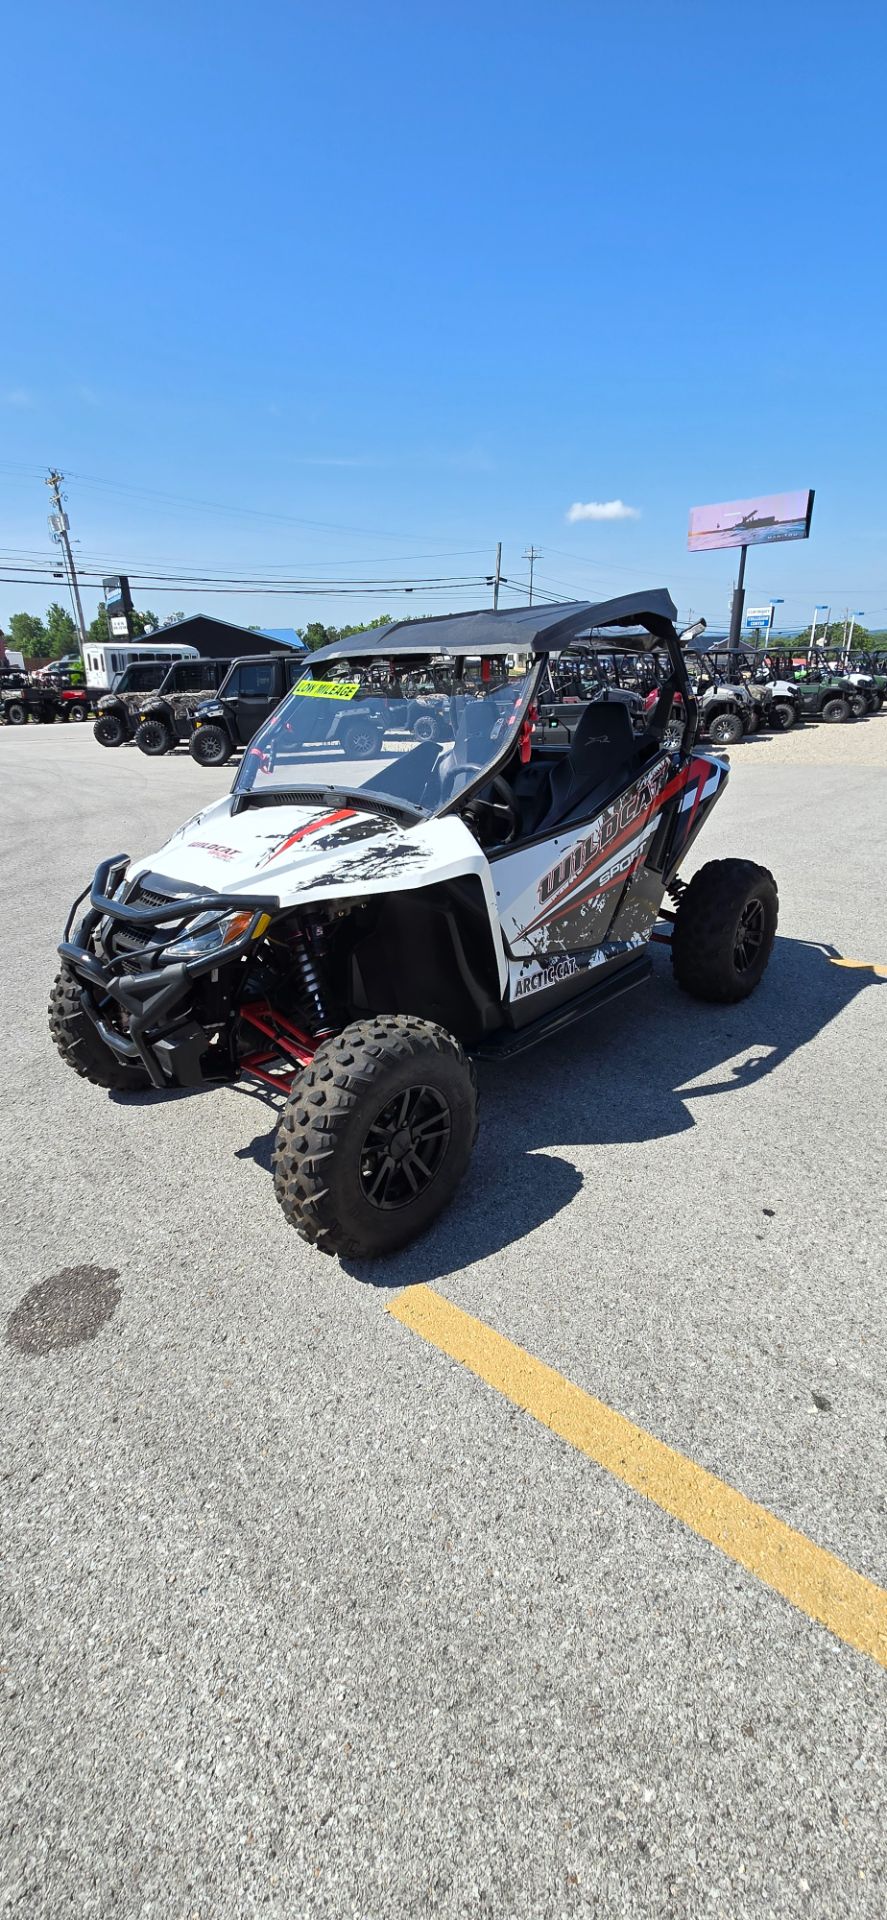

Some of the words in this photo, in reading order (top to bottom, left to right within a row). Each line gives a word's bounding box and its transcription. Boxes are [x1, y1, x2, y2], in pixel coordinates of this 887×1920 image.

[296, 682, 315, 693] LOW
[316, 684, 357, 697] MILEAGE
[187, 842, 242, 855] WILDCAT
[538, 768, 668, 904] WILDCAT
[599, 843, 647, 887] SPORT
[515, 966, 555, 998] ARCTIC
[556, 958, 576, 979] CAT
